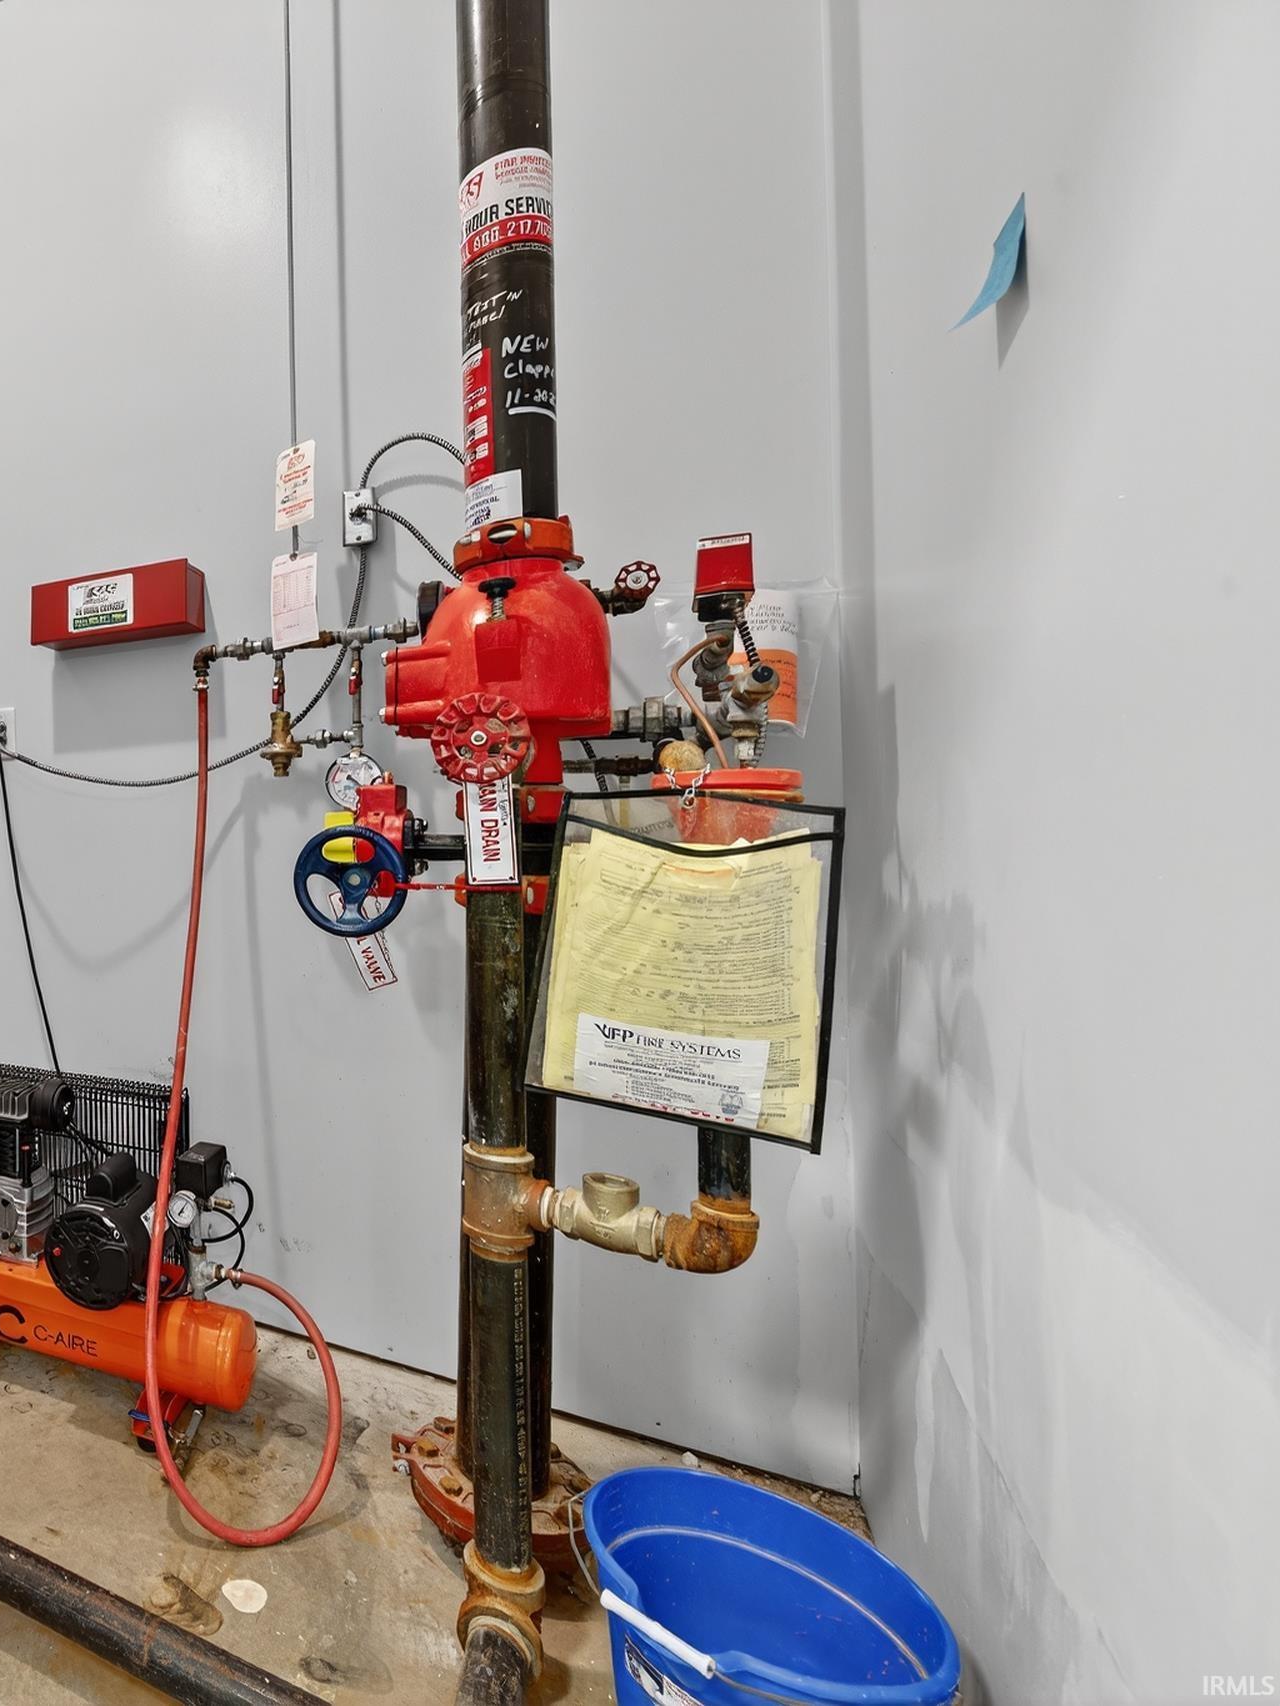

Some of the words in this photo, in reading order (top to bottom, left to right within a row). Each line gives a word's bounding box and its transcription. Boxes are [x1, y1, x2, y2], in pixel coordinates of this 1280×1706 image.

[501, 335, 548, 358] NEW
[481, 818, 501, 863] DRAIN
[361, 946, 387, 983] VALVE
[594, 1022, 634, 1043] VFP
[636, 1033, 665, 1049] FIRE
[670, 1039, 742, 1060] SYSTEMS
[33, 1324, 98, 1358] C-AIRE
